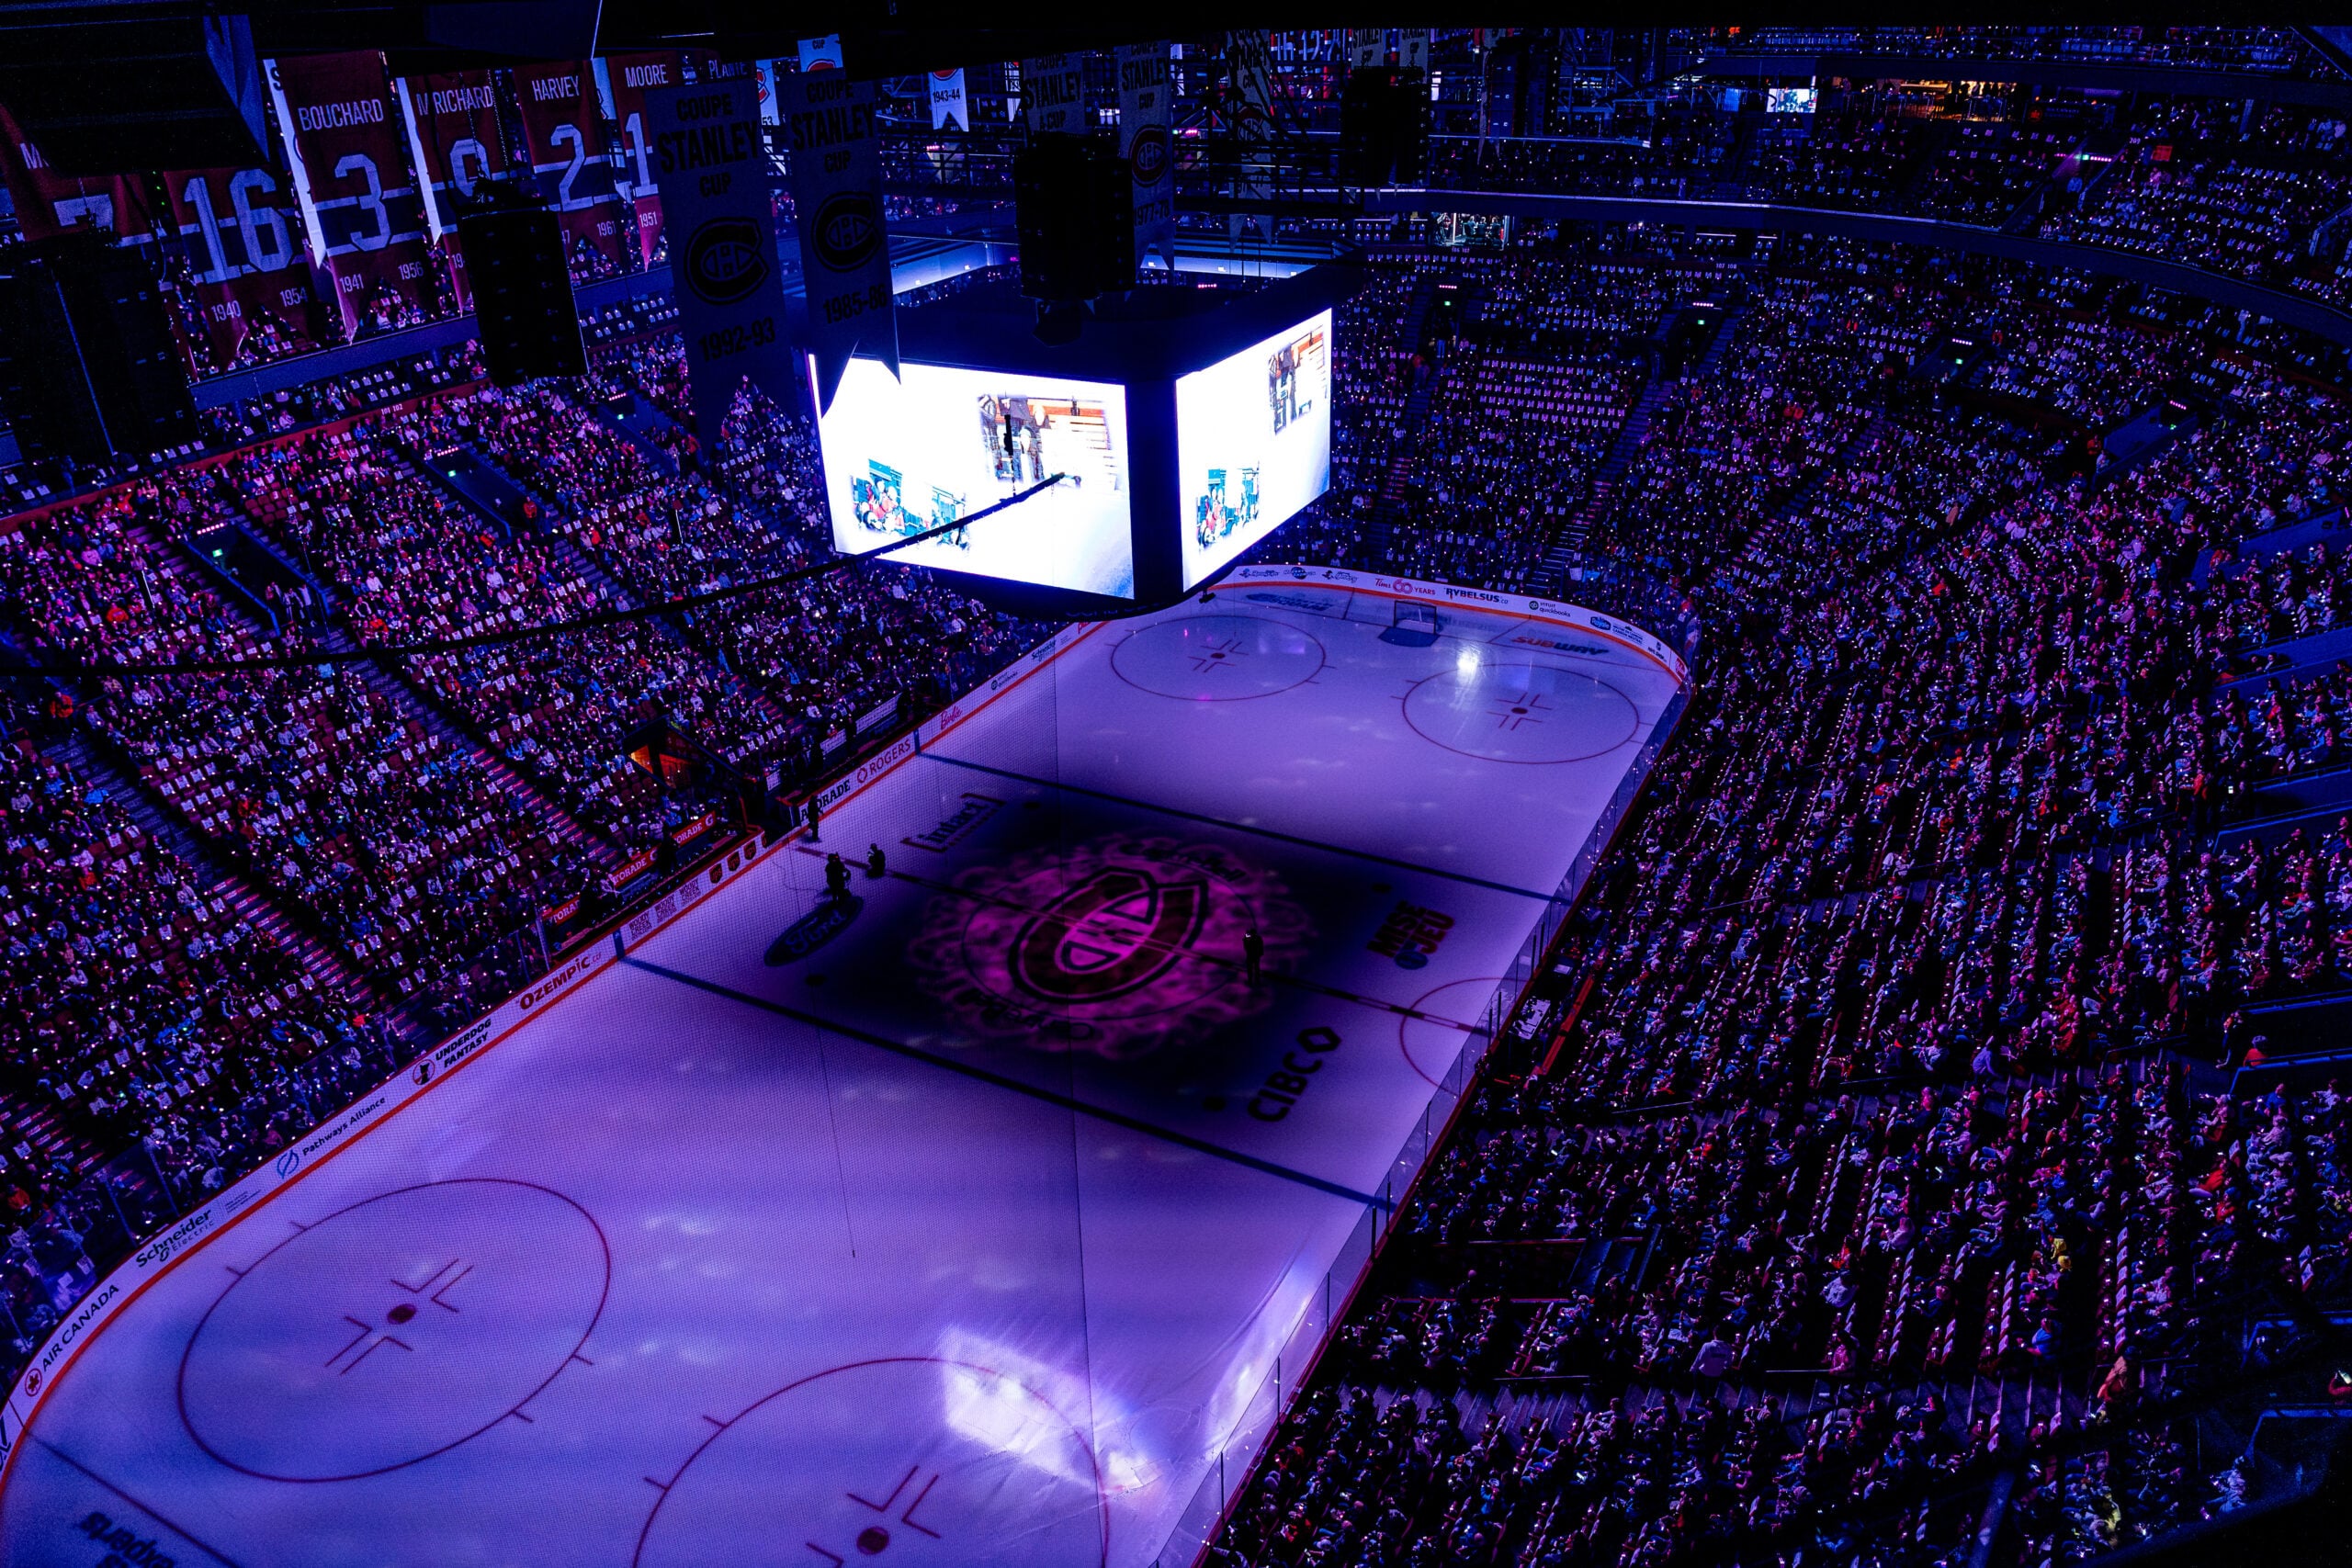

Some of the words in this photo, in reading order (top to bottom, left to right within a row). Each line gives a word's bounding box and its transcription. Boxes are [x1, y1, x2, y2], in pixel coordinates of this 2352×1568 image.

[812, 39, 825, 50] CUP
[531, 74, 581, 102] HARVEY
[625, 63, 669, 88] MOORE
[1122, 57, 1170, 92] STANLEY
[434, 85, 493, 115] RICHARD
[807, 79, 854, 104] COUPE
[932, 87, 961, 104] 1943-44
[1138, 94, 1155, 110] CUP
[297, 98, 384, 131] BOUCHARD
[675, 94, 733, 121] COUPE
[791, 101, 874, 152] STANLEY
[659, 120, 758, 174] STANLEY
[825, 150, 852, 173] CUP
[550, 122, 594, 213] 2
[699, 173, 732, 197] CUP
[334, 152, 392, 253] 3
[1134, 197, 1170, 227] 1977-78
[184, 168, 294, 285] 16
[596, 220, 616, 239] 1961
[639, 211, 659, 229] 1951
[339, 274, 365, 294] 1941
[398, 260, 424, 281] 1956
[210, 299, 242, 323] 1940
[279, 286, 310, 308] 1954
[824, 284, 888, 324] 1985-86
[698, 316, 776, 363] 1992-93
[1414, 586, 1435, 596] YEARS
[1539, 606, 1571, 618] quickbooks
[1513, 636, 1610, 656] SUBWAY
[869, 739, 911, 776] ROGERS
[435, 1019, 492, 1061] UNDERDOG
[444, 1032, 489, 1067] FANTASY
[1248, 1052, 1323, 1122] CIBC
[302, 1122, 348, 1156] Pathways
[349, 1097, 386, 1125] Alliance
[136, 1208, 211, 1268] Schneider
[171, 1220, 215, 1251] Electric
[42, 1343, 62, 1372] AIR
[62, 1284, 119, 1346] CANADA
